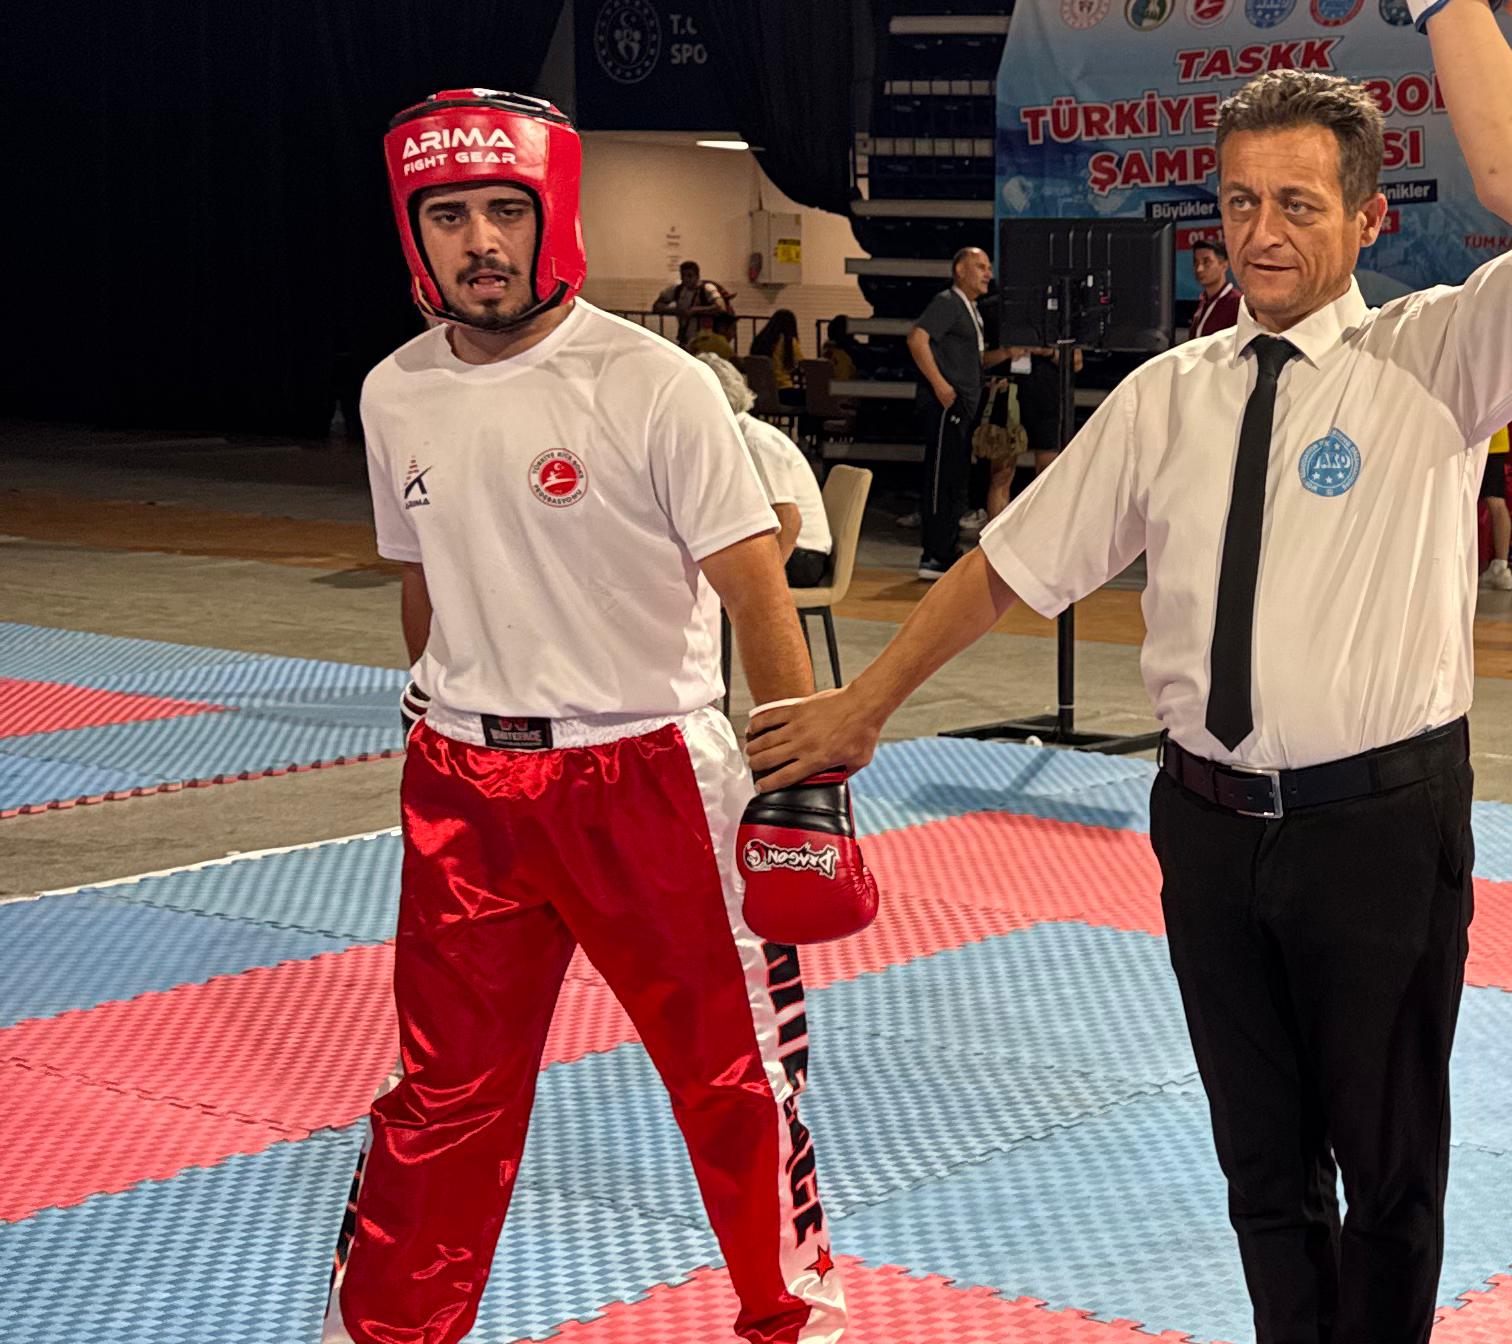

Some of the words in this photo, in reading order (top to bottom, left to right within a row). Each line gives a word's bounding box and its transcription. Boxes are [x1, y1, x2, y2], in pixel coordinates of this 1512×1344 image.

[1176, 36, 1340, 82] TASKK
[1021, 92, 1217, 143] TÜRKİYE
[402, 127, 516, 161] ARIMA
[403, 153, 449, 177] FIGHT
[454, 151, 517, 165] GEAR
[1151, 201, 1215, 220] Büyükler
[767, 848, 838, 876] DRAGON
